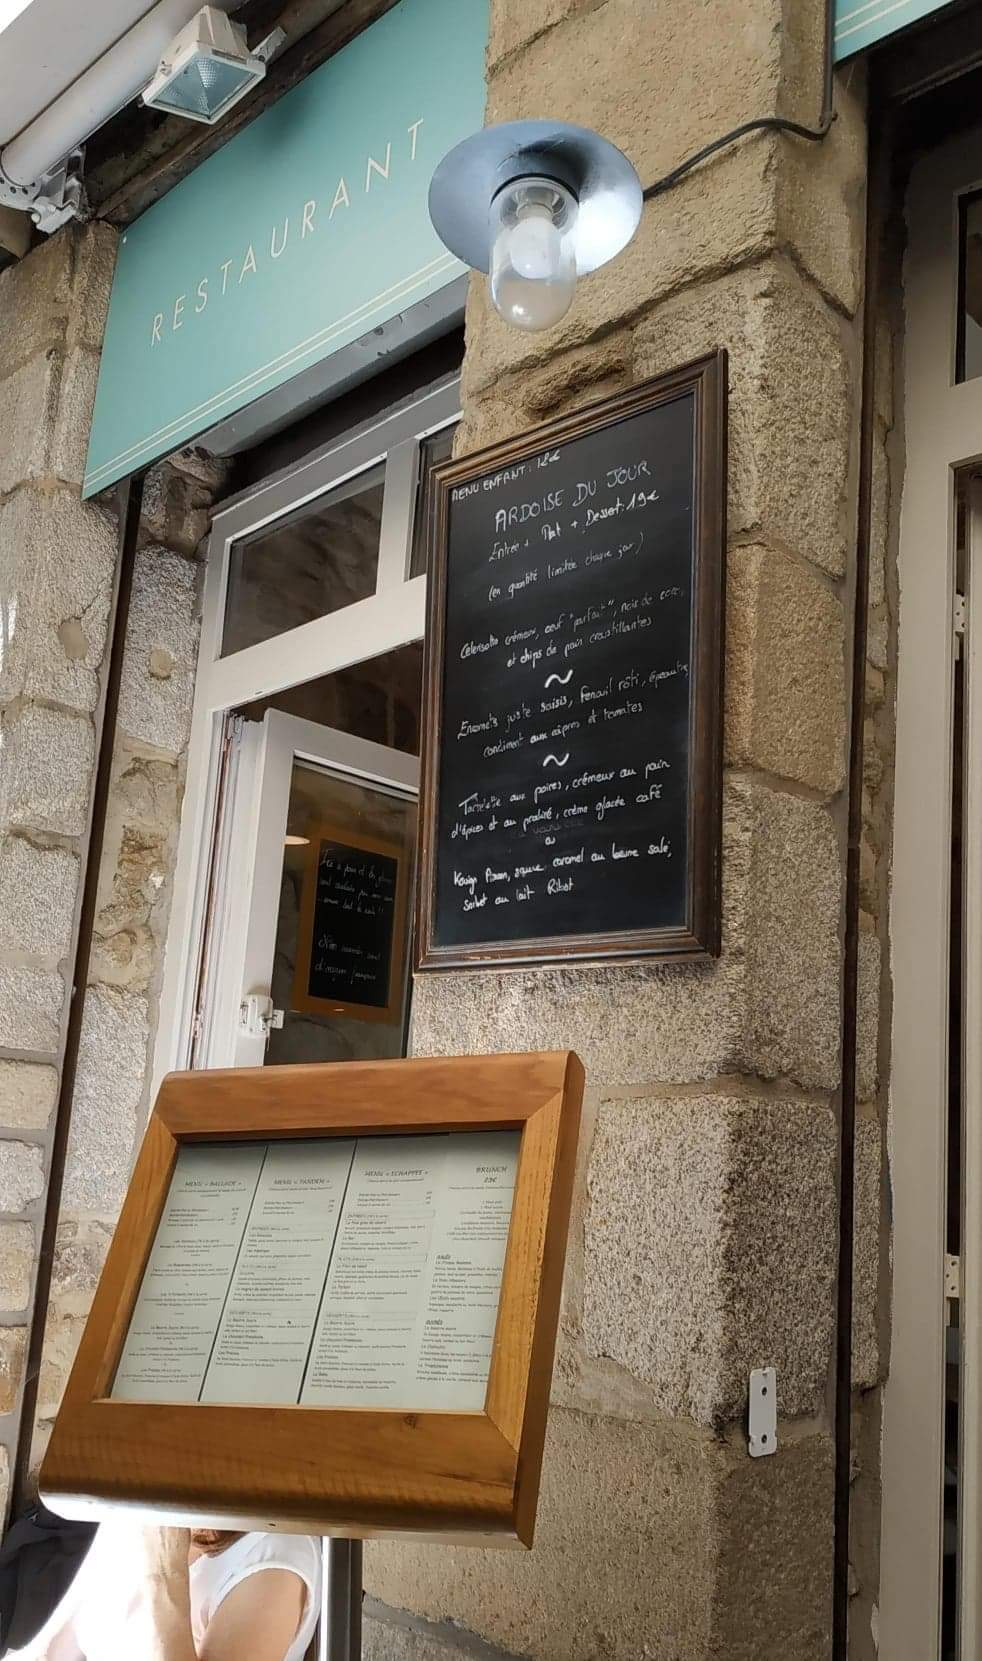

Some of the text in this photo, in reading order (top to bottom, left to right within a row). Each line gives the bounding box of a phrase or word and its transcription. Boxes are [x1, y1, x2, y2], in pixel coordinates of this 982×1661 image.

[152, 118, 424, 347] RESTAURANT
[495, 460, 651, 533] ARDOISE DU JOUR
[541, 522, 561, 541] Plat
[507, 652, 517, 668] et
[520, 647, 542, 669] chips
[546, 640, 557, 657] de
[564, 638, 583, 658] pain
[505, 703, 531, 733] juste
[530, 733, 548, 744] aux
[587, 708, 597, 724] et
[603, 699, 643, 720] tomates
[510, 793, 526, 802] aux
[572, 772, 615, 788] crémeux
[620, 768, 637, 778] au
[645, 759, 671, 779] pain
[488, 814, 498, 831] et
[503, 819, 517, 828] au
[563, 804, 588, 818] crème
[636, 784, 663, 803] café
[553, 846, 585, 867] caramel
[590, 853, 606, 862] au
[612, 842, 640, 860] beurre
[494, 896, 510, 905] au
[516, 884, 536, 901] lait
[547, 877, 574, 895] Ribot
